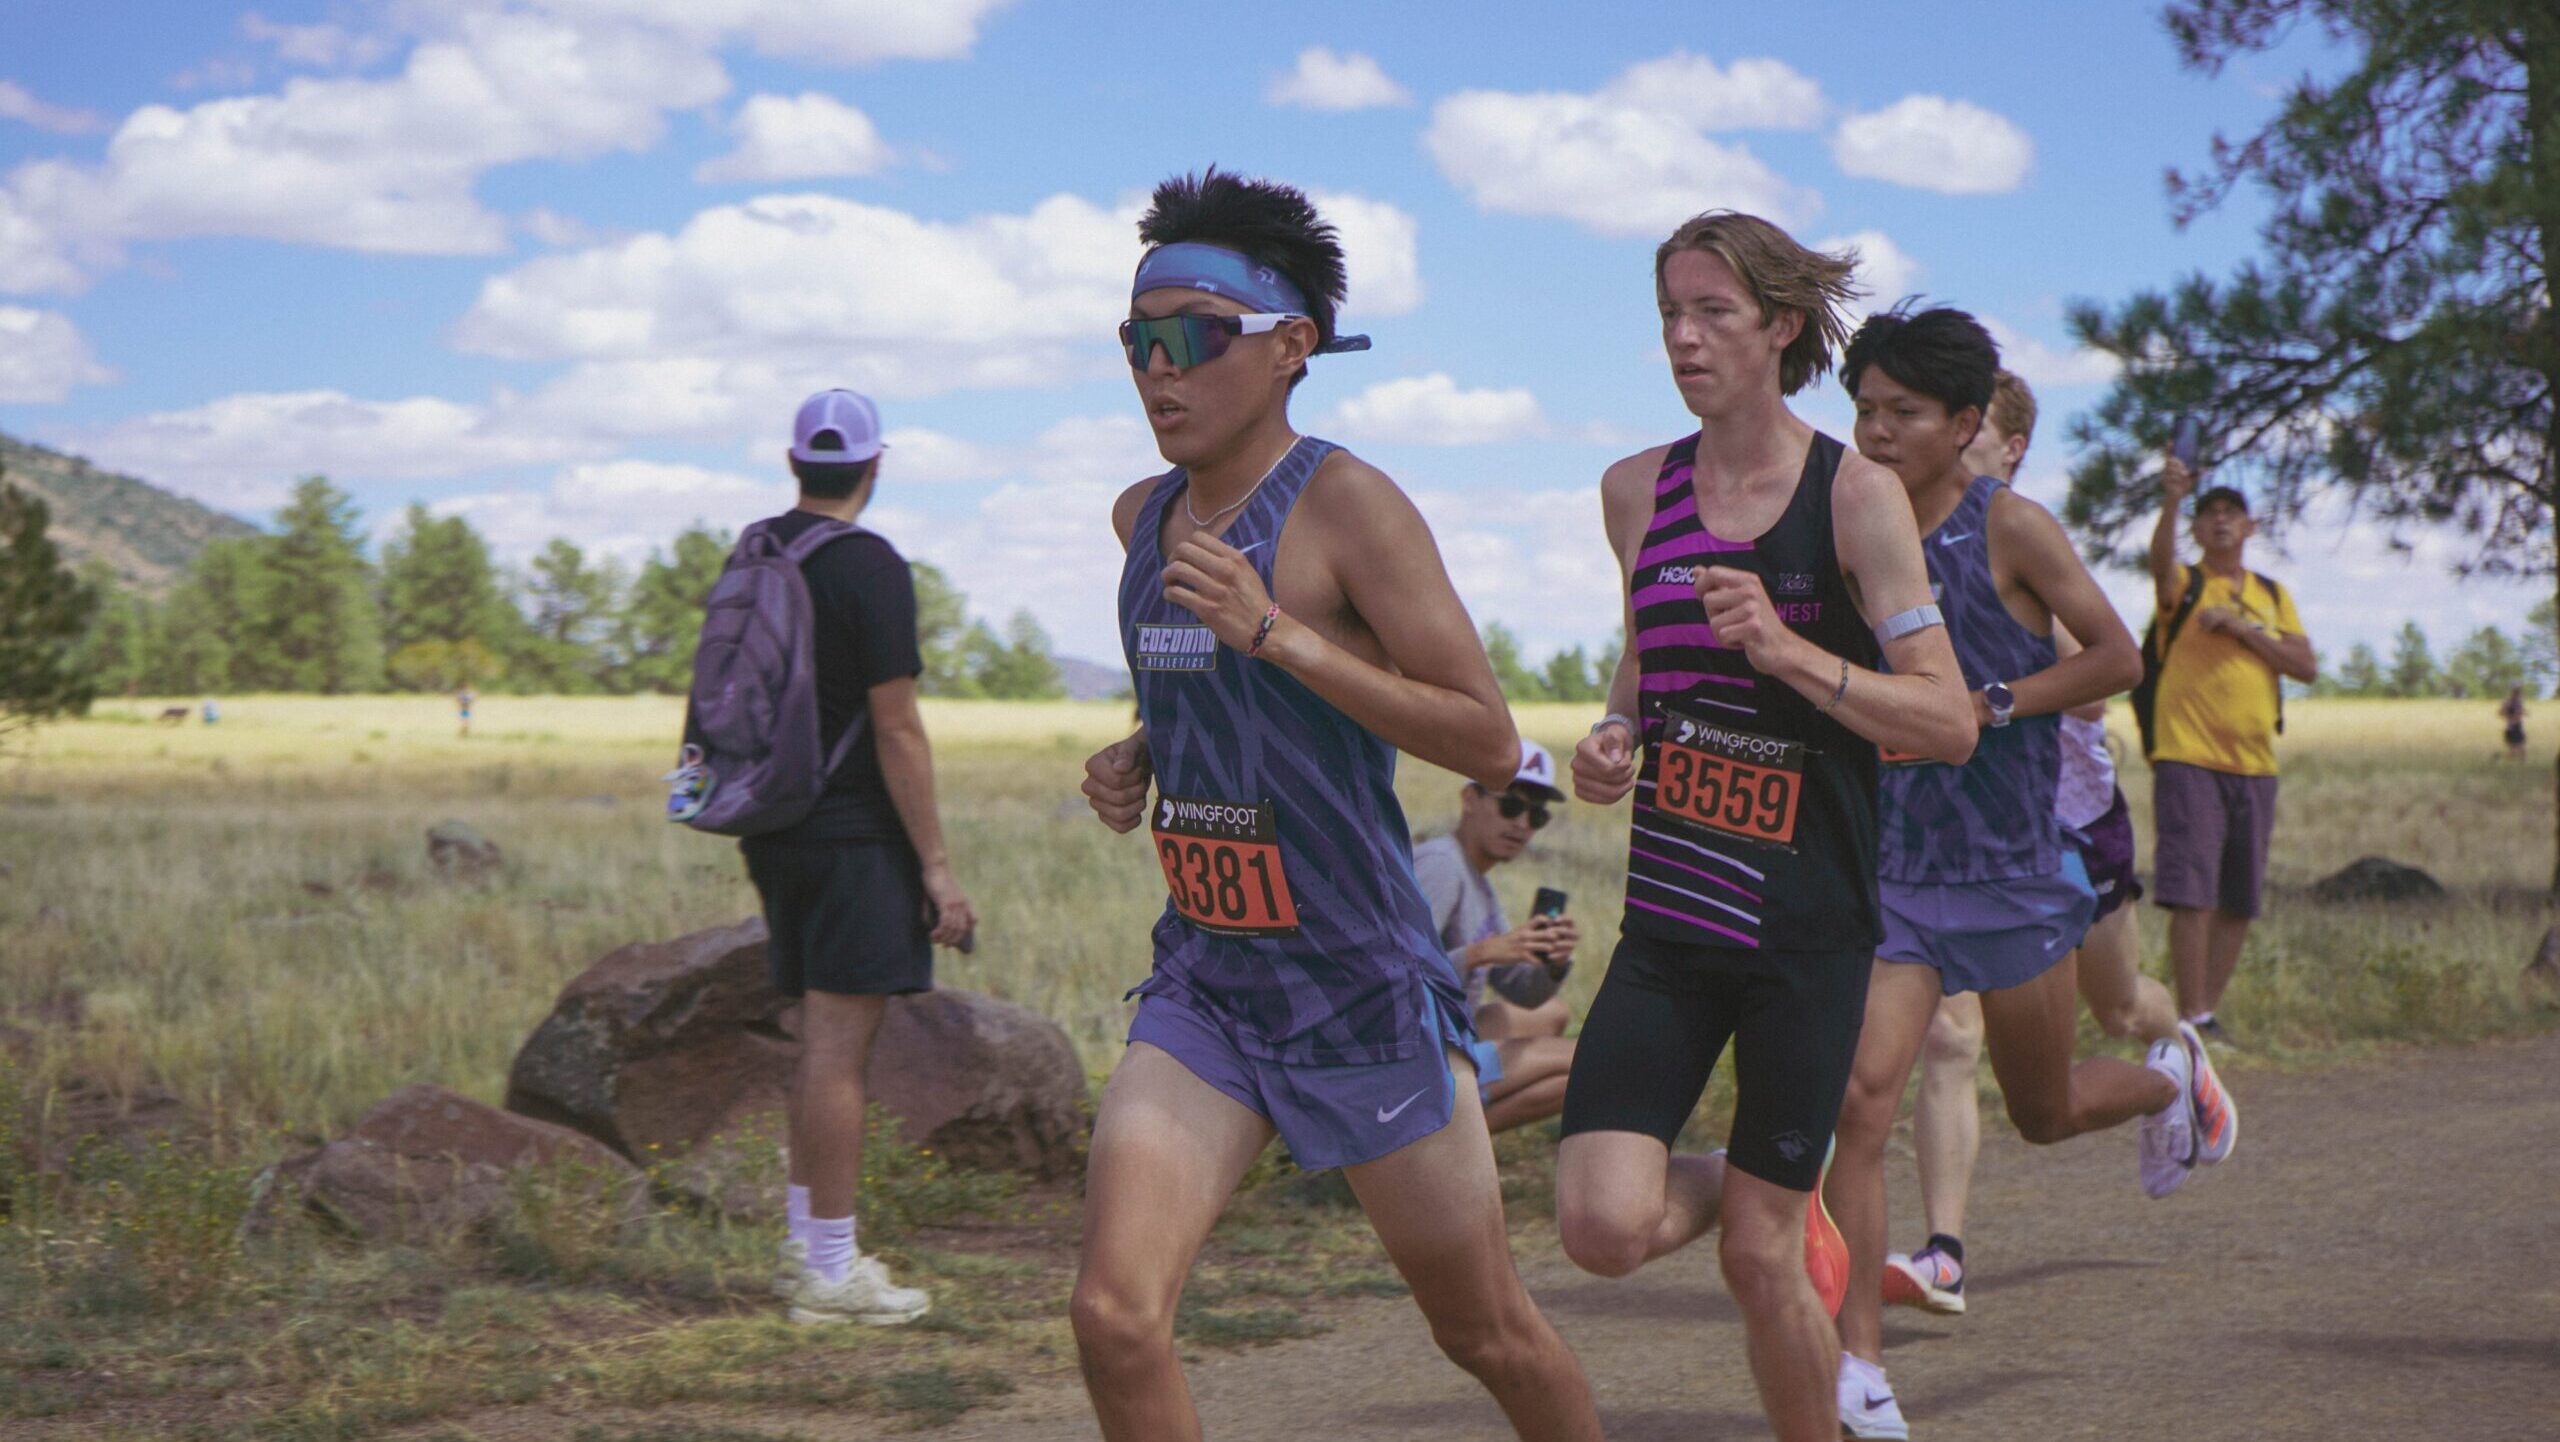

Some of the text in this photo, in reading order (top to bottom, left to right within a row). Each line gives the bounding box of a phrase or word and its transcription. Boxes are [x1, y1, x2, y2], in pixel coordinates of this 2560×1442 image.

[1139, 627, 1216, 653] COCONINO
[1147, 657, 1205, 668] ATHLETICS
[1698, 725, 1789, 756] WINGFOOT
[1699, 740, 1784, 764] FINISH
[1664, 750, 1789, 833] 3559
[1176, 801, 1258, 826] WINGFOOT
[1180, 819, 1257, 836] FINISH
[1161, 838, 1280, 921] 3381
